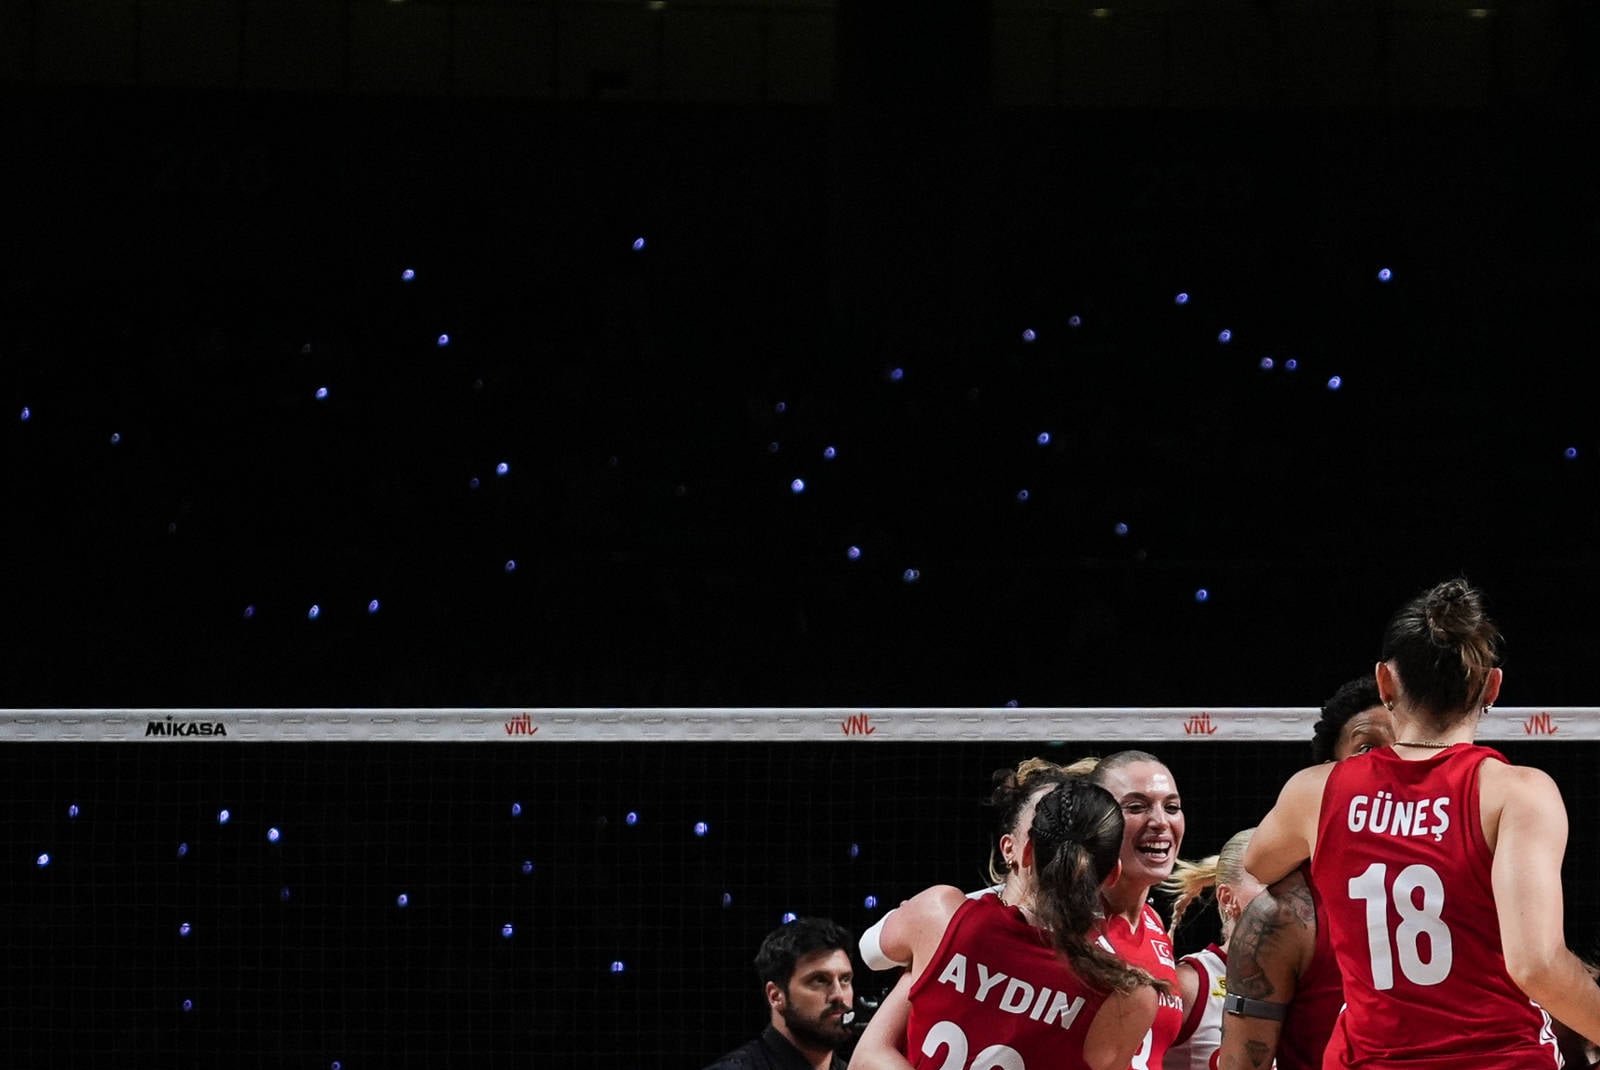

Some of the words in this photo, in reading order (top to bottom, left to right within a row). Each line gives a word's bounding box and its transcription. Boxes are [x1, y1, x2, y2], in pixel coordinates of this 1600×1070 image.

[504, 712, 539, 736] VNL
[841, 712, 876, 736] VNL
[1183, 712, 1218, 735] VNL
[1523, 711, 1558, 735] VNL
[1347, 791, 1450, 842] GÜNEŞ
[1348, 863, 1453, 990] 18
[938, 953, 1087, 1030] AYDIN
